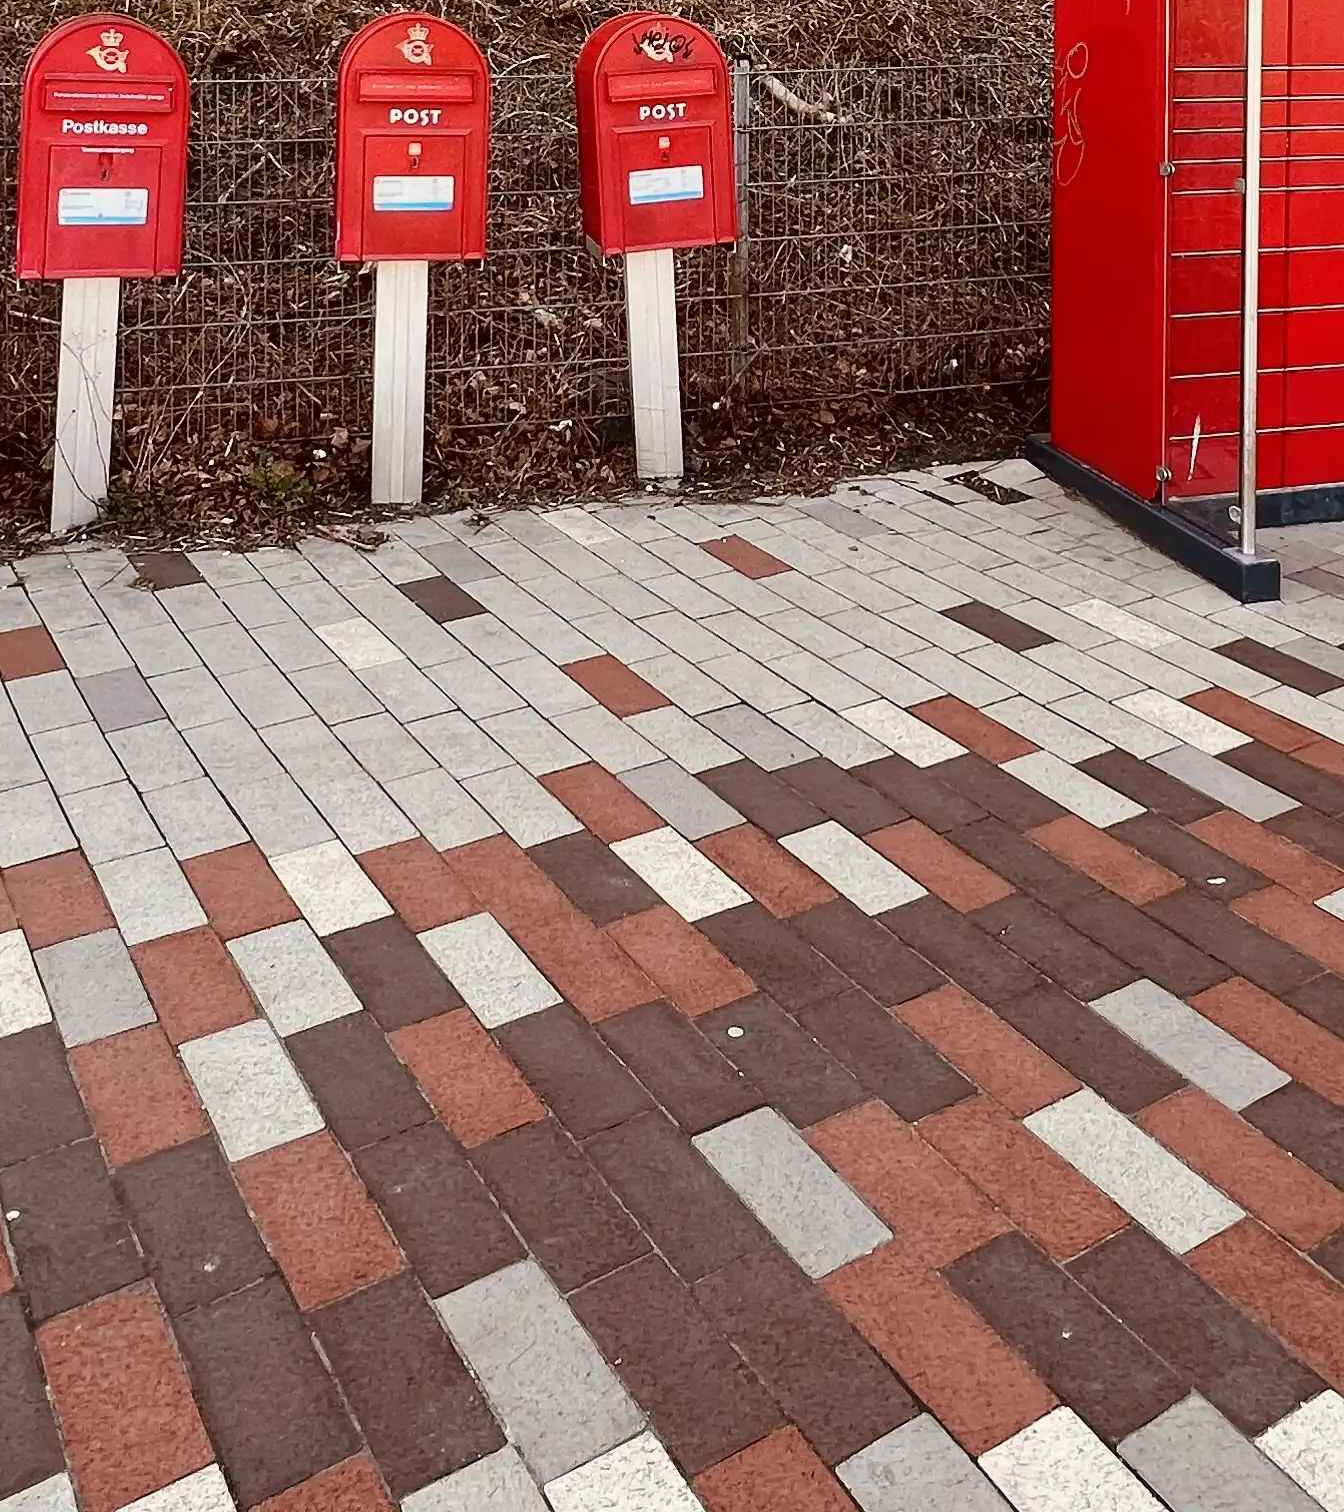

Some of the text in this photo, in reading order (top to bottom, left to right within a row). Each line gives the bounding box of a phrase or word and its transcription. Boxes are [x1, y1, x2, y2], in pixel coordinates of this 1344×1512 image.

[389, 108, 443, 127] POST
[639, 102, 687, 121] POST
[61, 118, 149, 136] Postkasse
